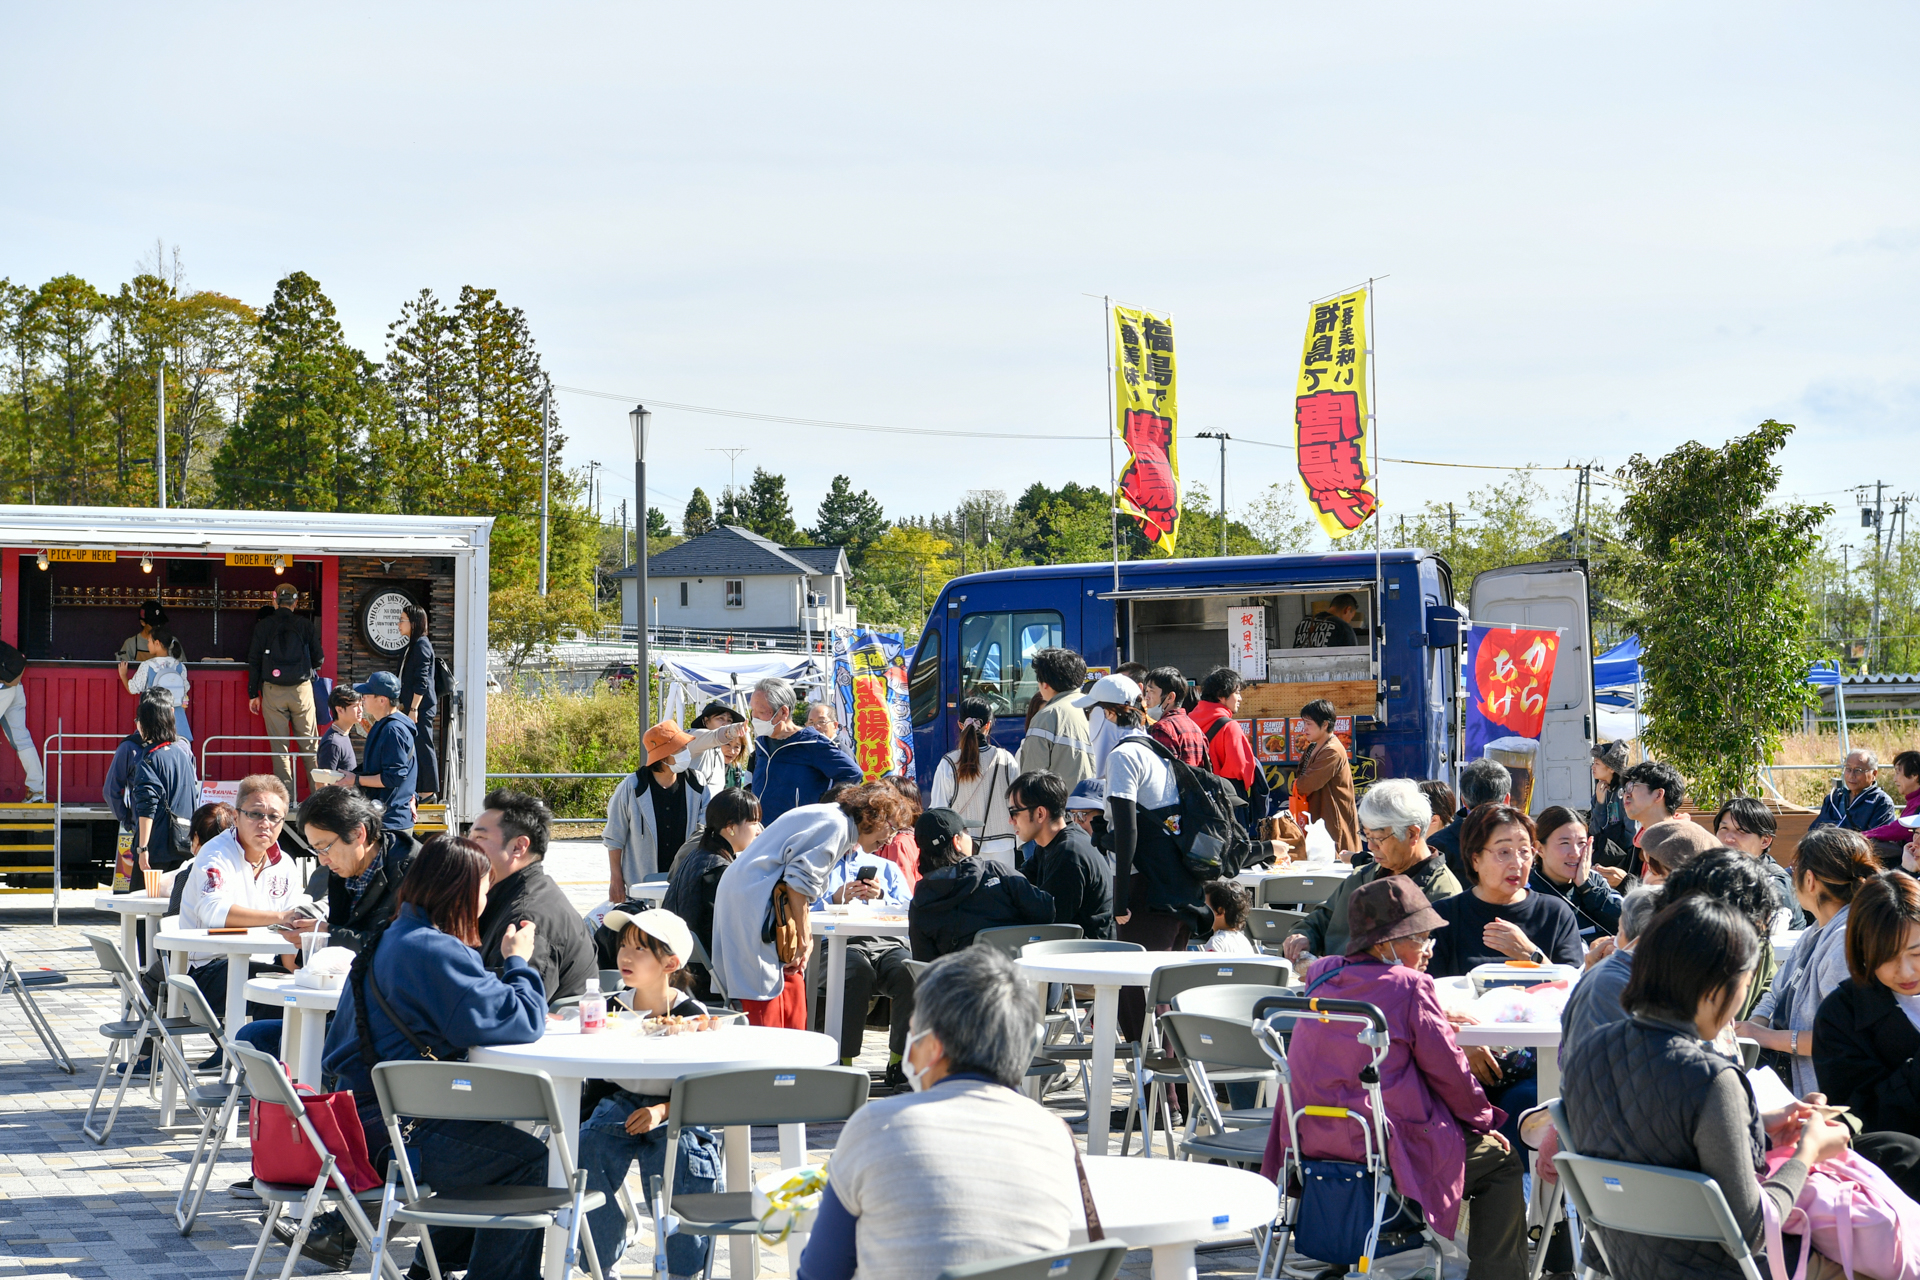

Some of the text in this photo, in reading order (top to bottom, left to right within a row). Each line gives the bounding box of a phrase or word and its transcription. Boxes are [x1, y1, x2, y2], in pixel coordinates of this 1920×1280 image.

[1141, 317, 1174, 413] 福島で
[51, 550, 112, 561] PICK-UP HERE
[234, 554, 260, 565] ORDER
[369, 597, 385, 626] WHISKY
[1240, 612, 1254, 659] 祝 日本一
[852, 651, 886, 671] 美味
[1263, 721, 1284, 729] SEAWEED
